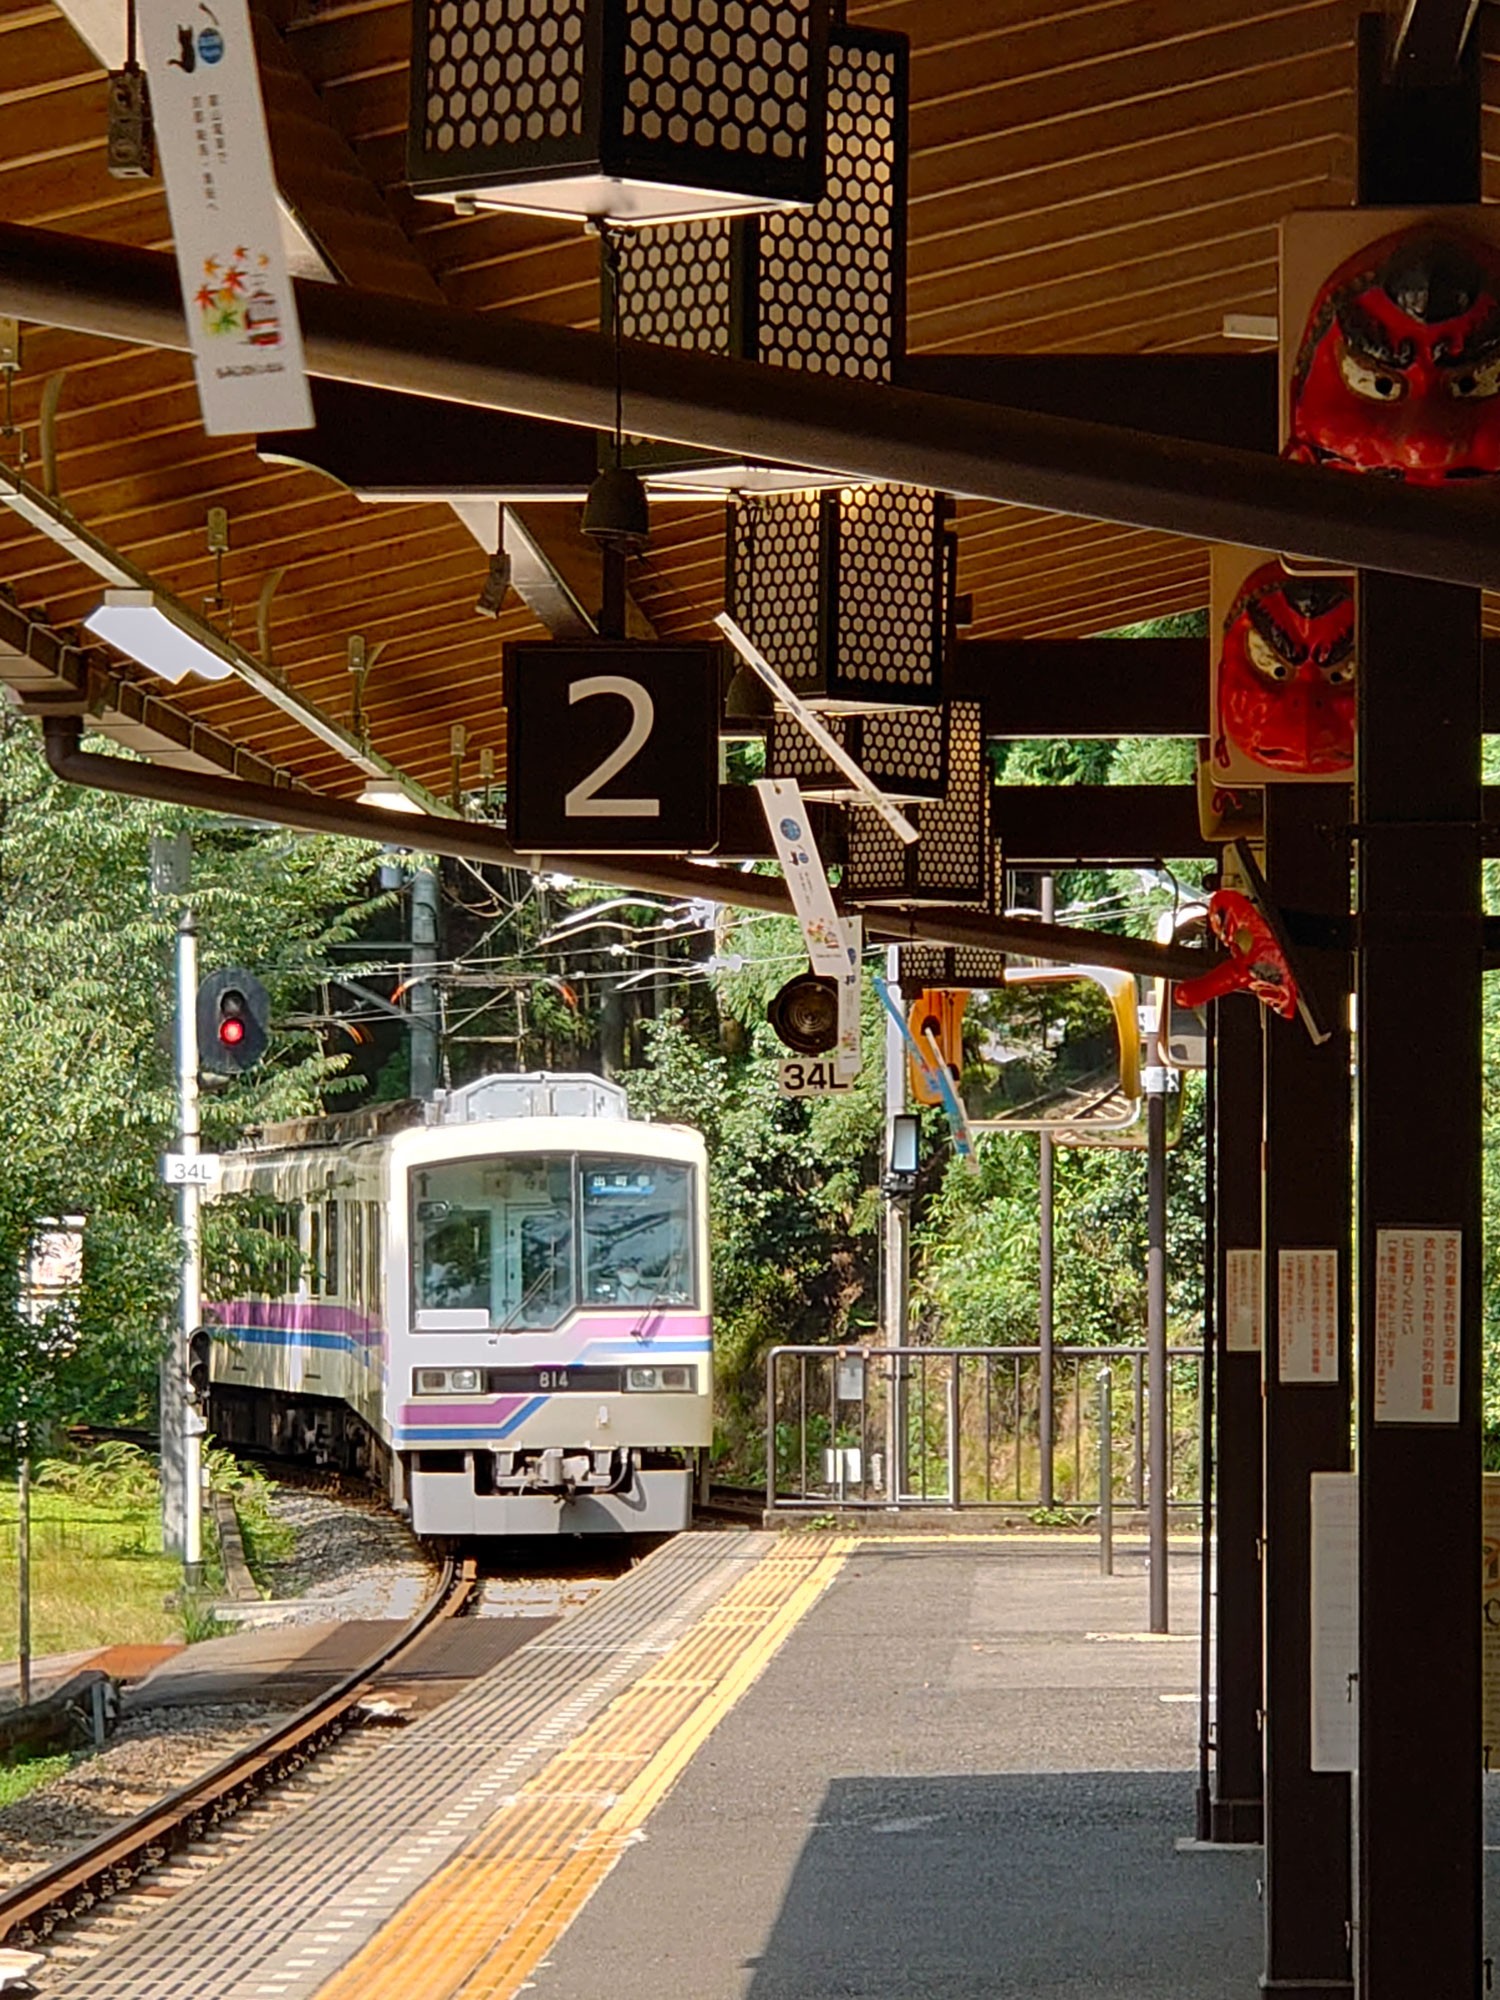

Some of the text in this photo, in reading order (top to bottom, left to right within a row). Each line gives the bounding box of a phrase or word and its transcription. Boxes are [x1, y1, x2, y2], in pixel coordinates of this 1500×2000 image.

[565, 675, 660, 817] 2
[784, 1063, 849, 1090] 34L
[174, 1163, 212, 1180] 34L
[540, 1371, 568, 1387] 814
